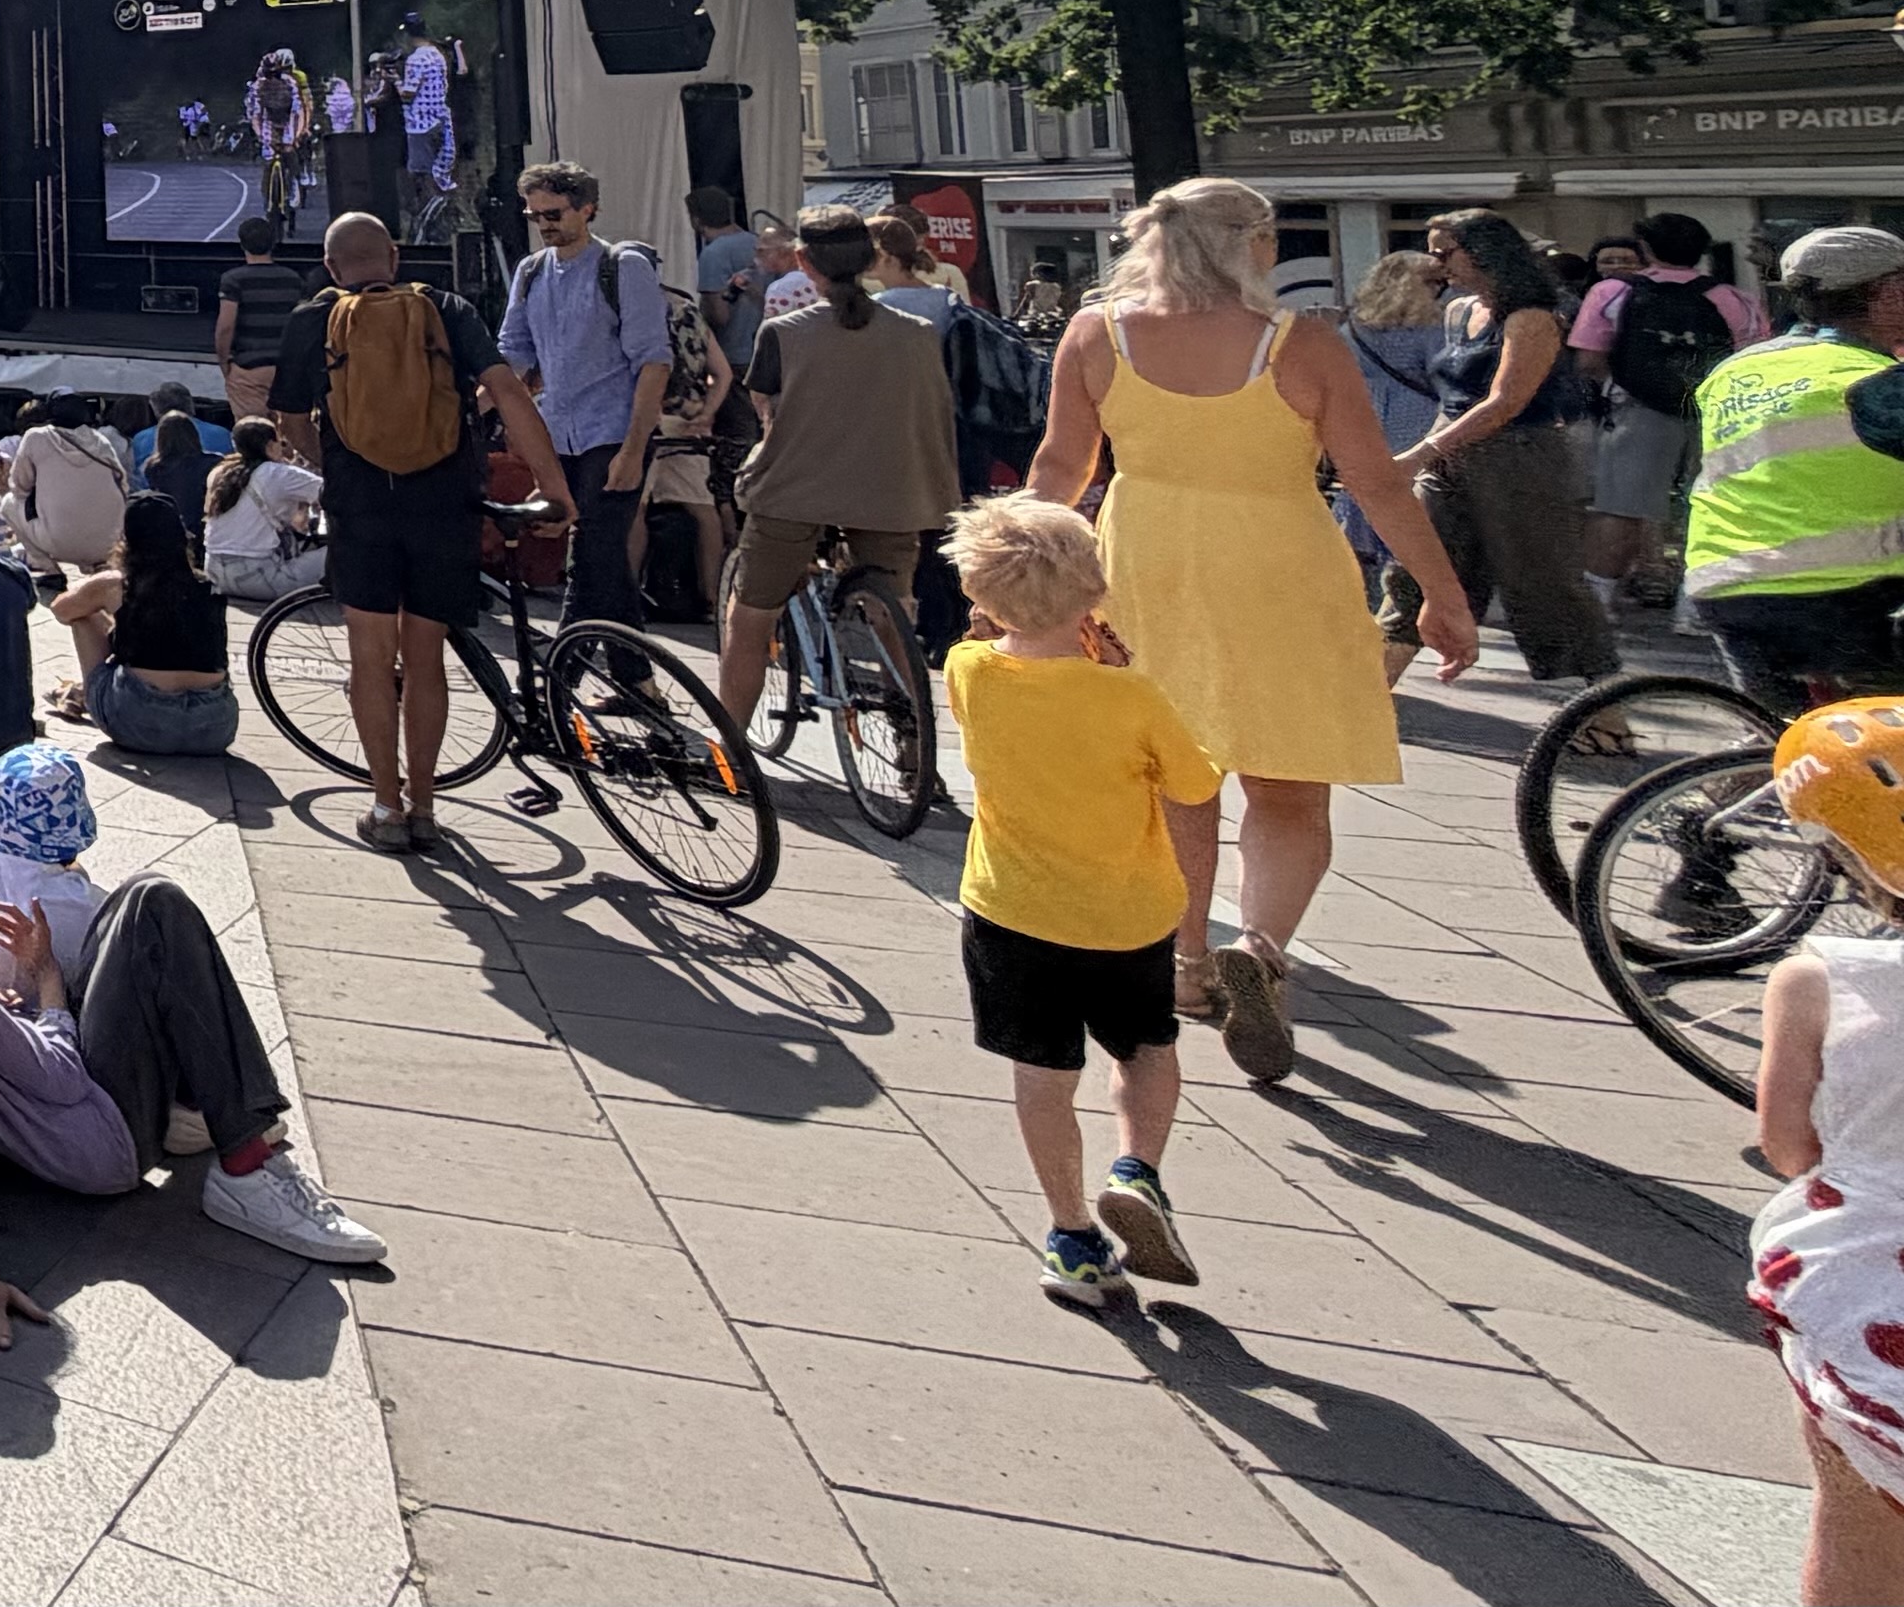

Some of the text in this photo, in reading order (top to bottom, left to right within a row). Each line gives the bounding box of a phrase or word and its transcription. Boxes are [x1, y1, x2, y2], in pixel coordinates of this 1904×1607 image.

[1694, 110, 1767, 132] BNP
[1288, 124, 1443, 145] BNP PARIBAS
[928, 216, 974, 240] ERISE
